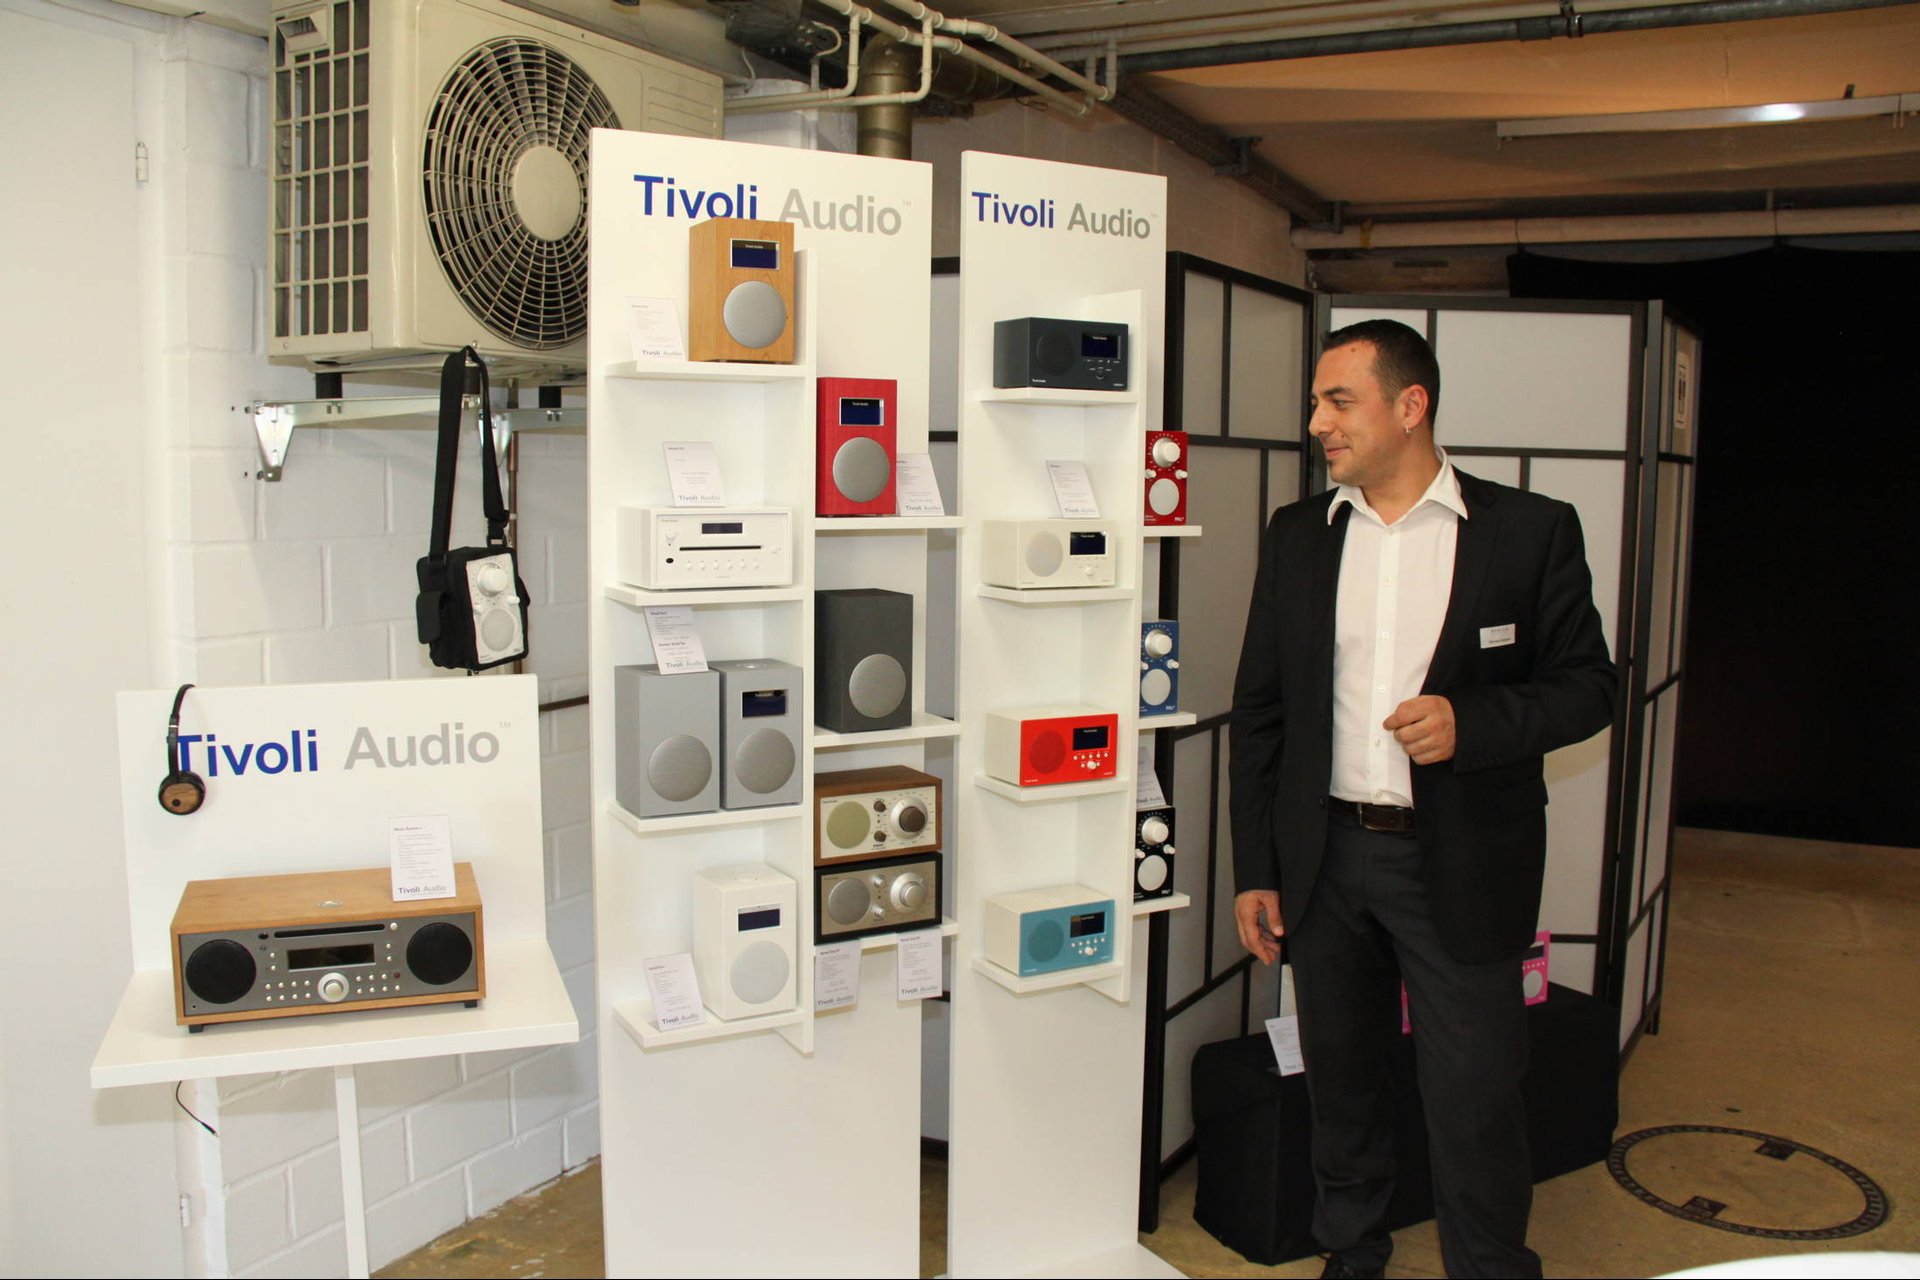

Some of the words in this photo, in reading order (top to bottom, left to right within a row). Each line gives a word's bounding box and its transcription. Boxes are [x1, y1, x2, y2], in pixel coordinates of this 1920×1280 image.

[634, 174, 757, 220] Tivoli
[778, 188, 901, 236] Audio
[971, 191, 1054, 229] Tivoli
[1067, 203, 1151, 239] Audio
[167, 728, 319, 778] Tivoli
[343, 722, 500, 770] Audio
[398, 886, 421, 894] Tivoli
